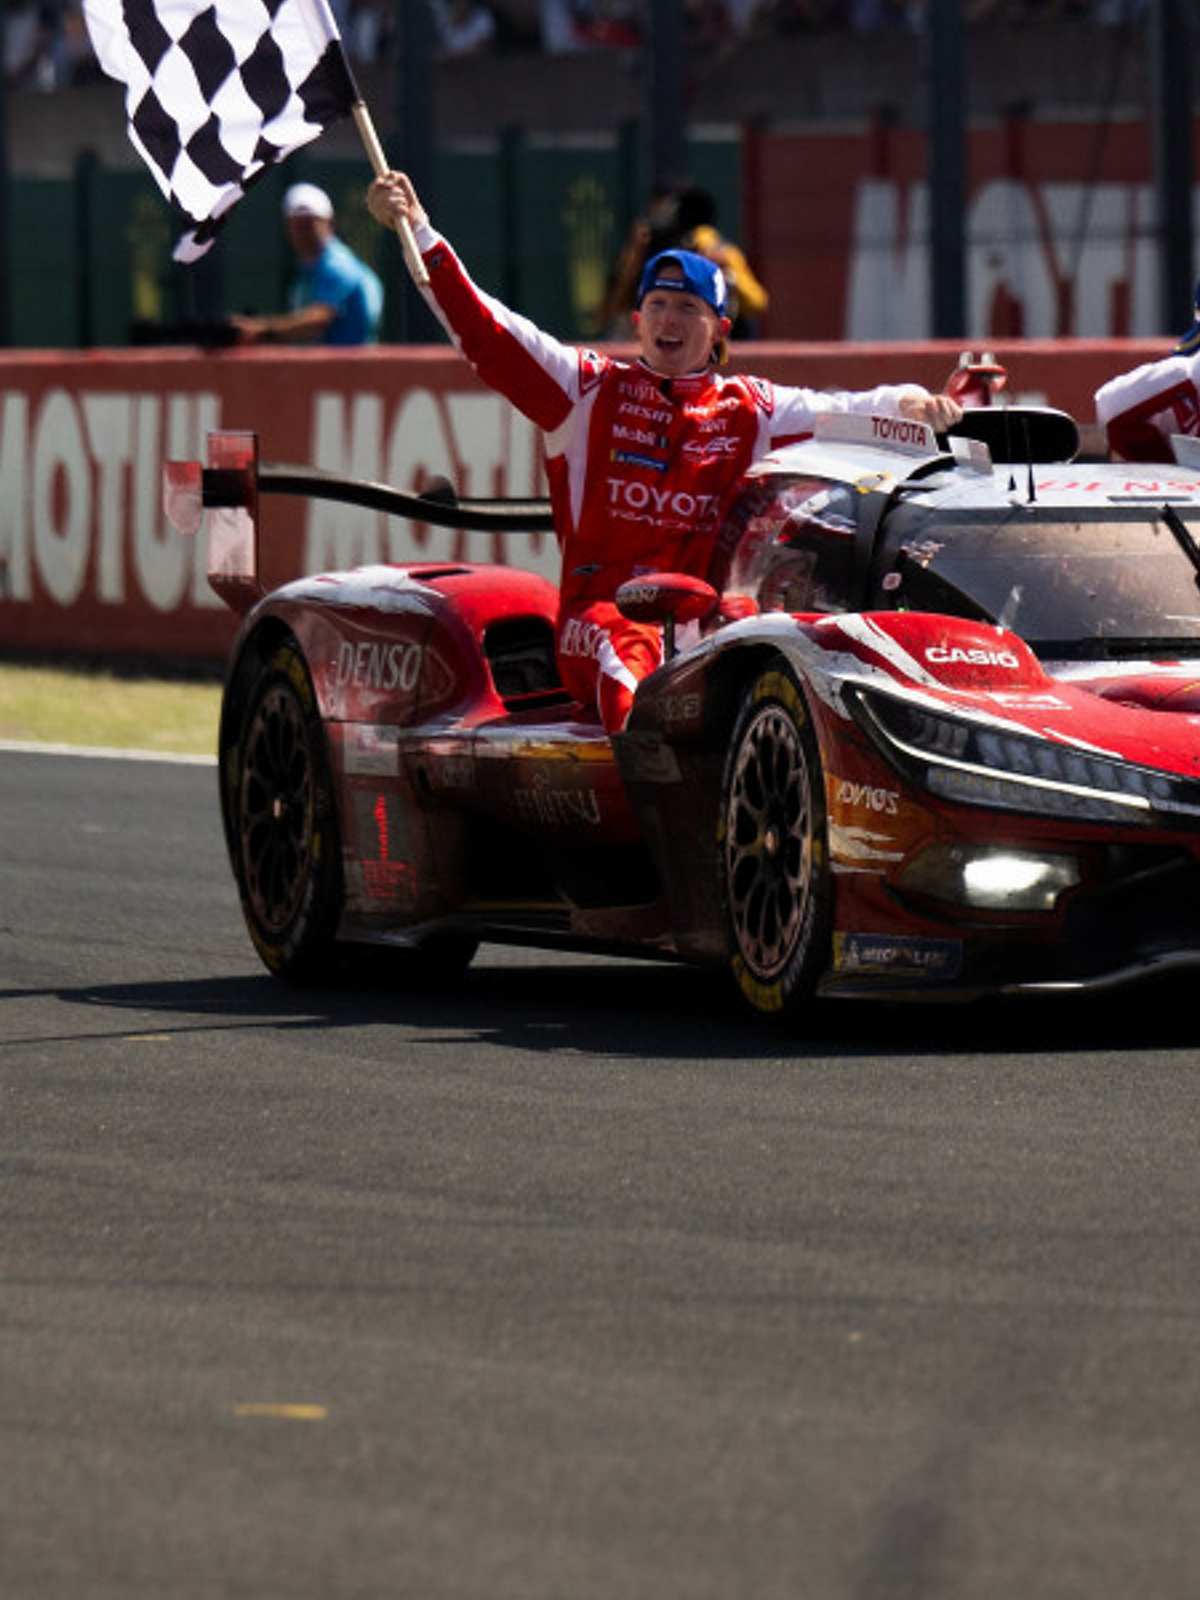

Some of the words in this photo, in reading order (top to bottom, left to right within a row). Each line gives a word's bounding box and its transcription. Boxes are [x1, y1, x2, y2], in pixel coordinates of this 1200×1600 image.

[870, 416, 928, 447] TOYOTA
[606, 479, 721, 518] TOYOTA
[336, 641, 423, 692] DENSO
[924, 647, 1020, 668] CASIO
